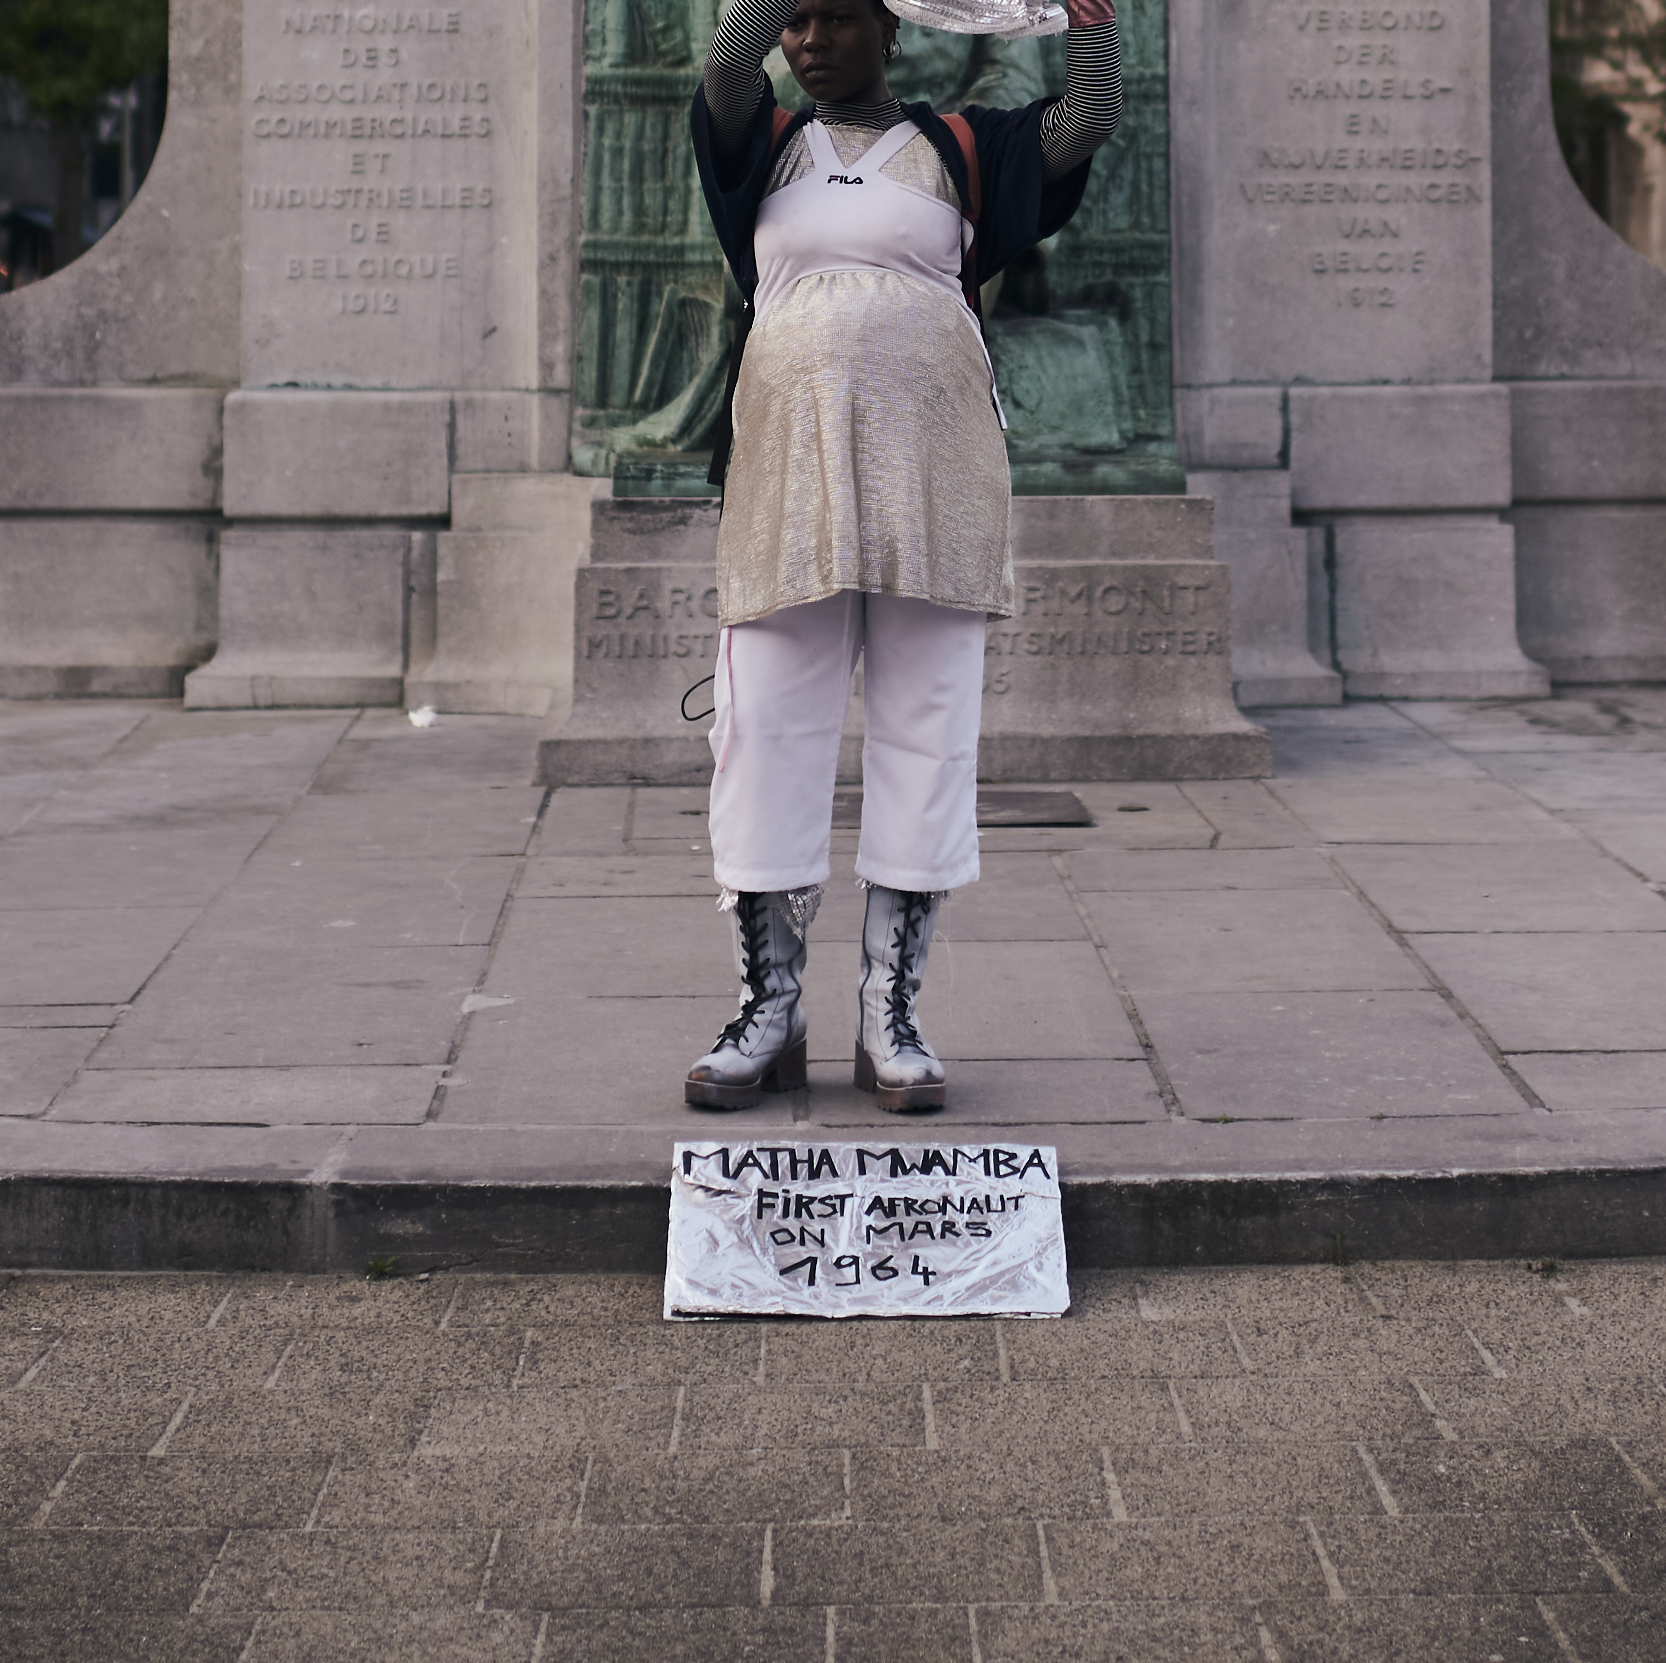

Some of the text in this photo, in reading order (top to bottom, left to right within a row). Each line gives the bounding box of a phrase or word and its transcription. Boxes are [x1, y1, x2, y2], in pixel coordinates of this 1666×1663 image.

[283, 10, 461, 34] NATIONALE
[1293, 9, 1446, 31] VERBOND
[339, 46, 400, 69] DES
[1334, 43, 1397, 66] DER
[252, 81, 490, 104] ASSOCIATIONS
[1288, 78, 1454, 101] HANDELS-
[250, 116, 492, 139] COMMERCIALES
[1345, 113, 1390, 135] EN
[349, 151, 391, 175] ET
[827, 175, 864, 184] FILA
[248, 187, 494, 210] INDUSTRIELLES
[348, 222, 390, 244] DE
[1337, 217, 1400, 239] VAN
[285, 256, 460, 280] BELGIQUE
[337, 290, 398, 315] 1912
[683, 1147, 1052, 1181] MATHA MWAMBA
[864, 1194, 1026, 1221] AFRONAUT
[769, 1220, 993, 1248] ON MARS
[779, 1254, 937, 1287] 1964
